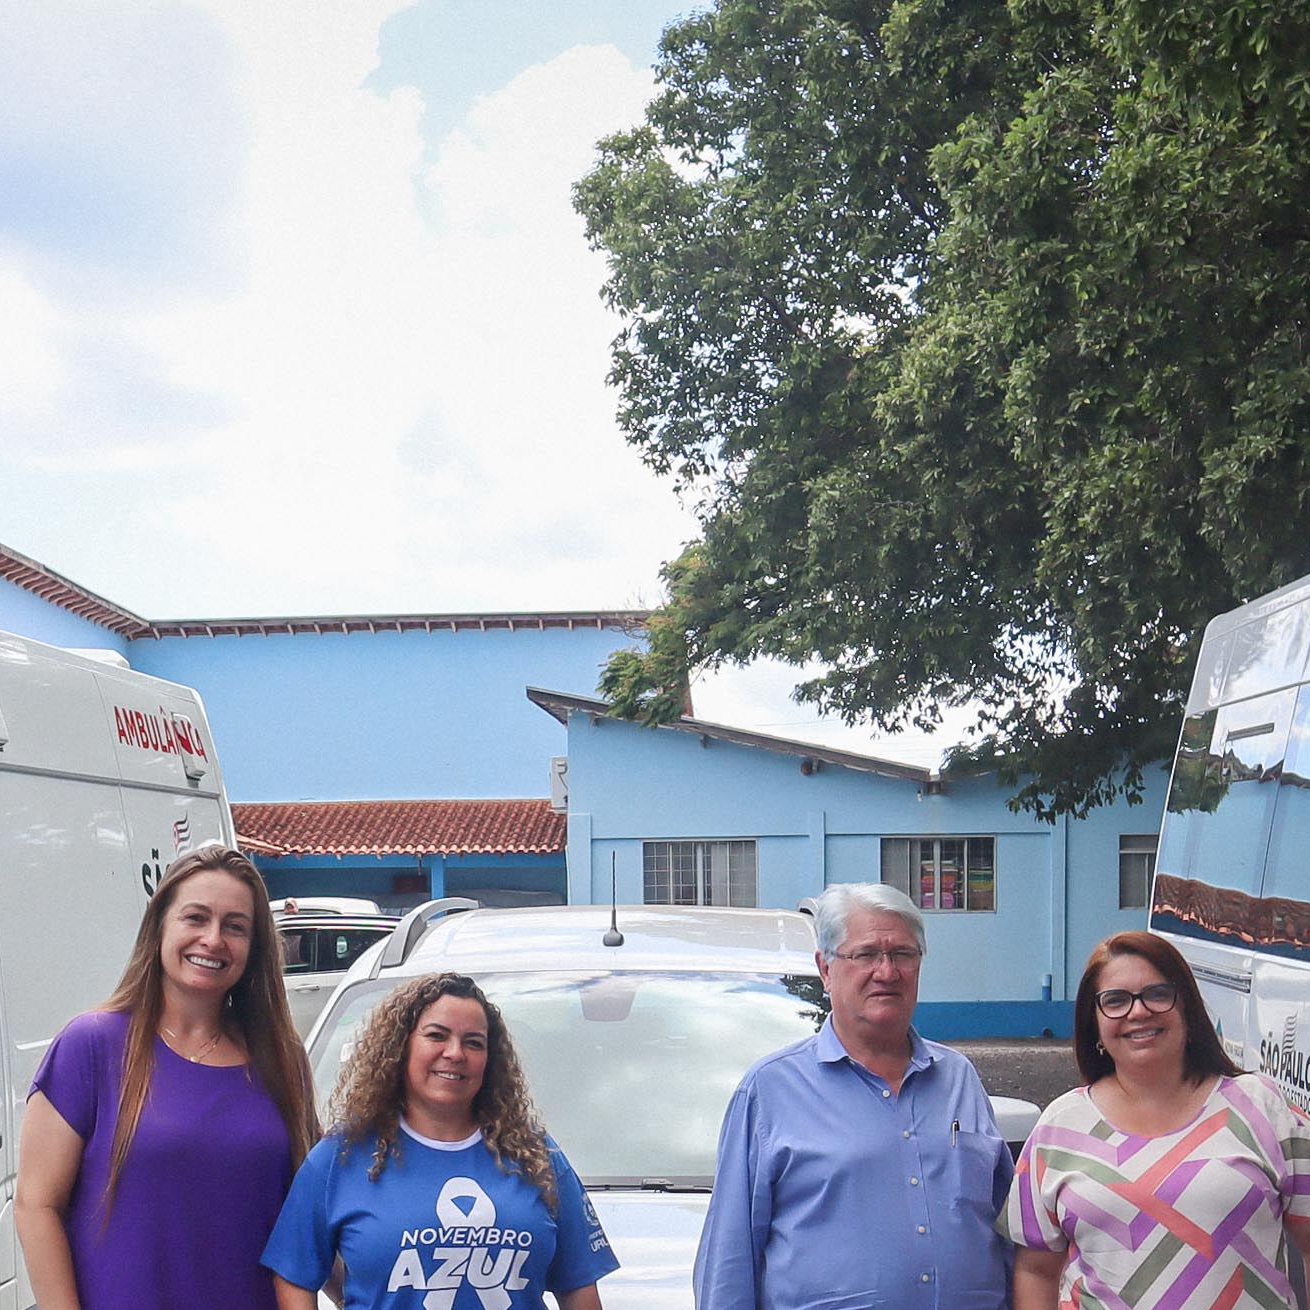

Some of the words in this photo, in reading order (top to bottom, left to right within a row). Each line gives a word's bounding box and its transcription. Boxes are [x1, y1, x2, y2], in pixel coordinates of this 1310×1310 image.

[1259, 1031, 1280, 1078] SÃO
[400, 1227, 534, 1248] NOVEMBRO
[387, 1247, 531, 1293] AZUL
